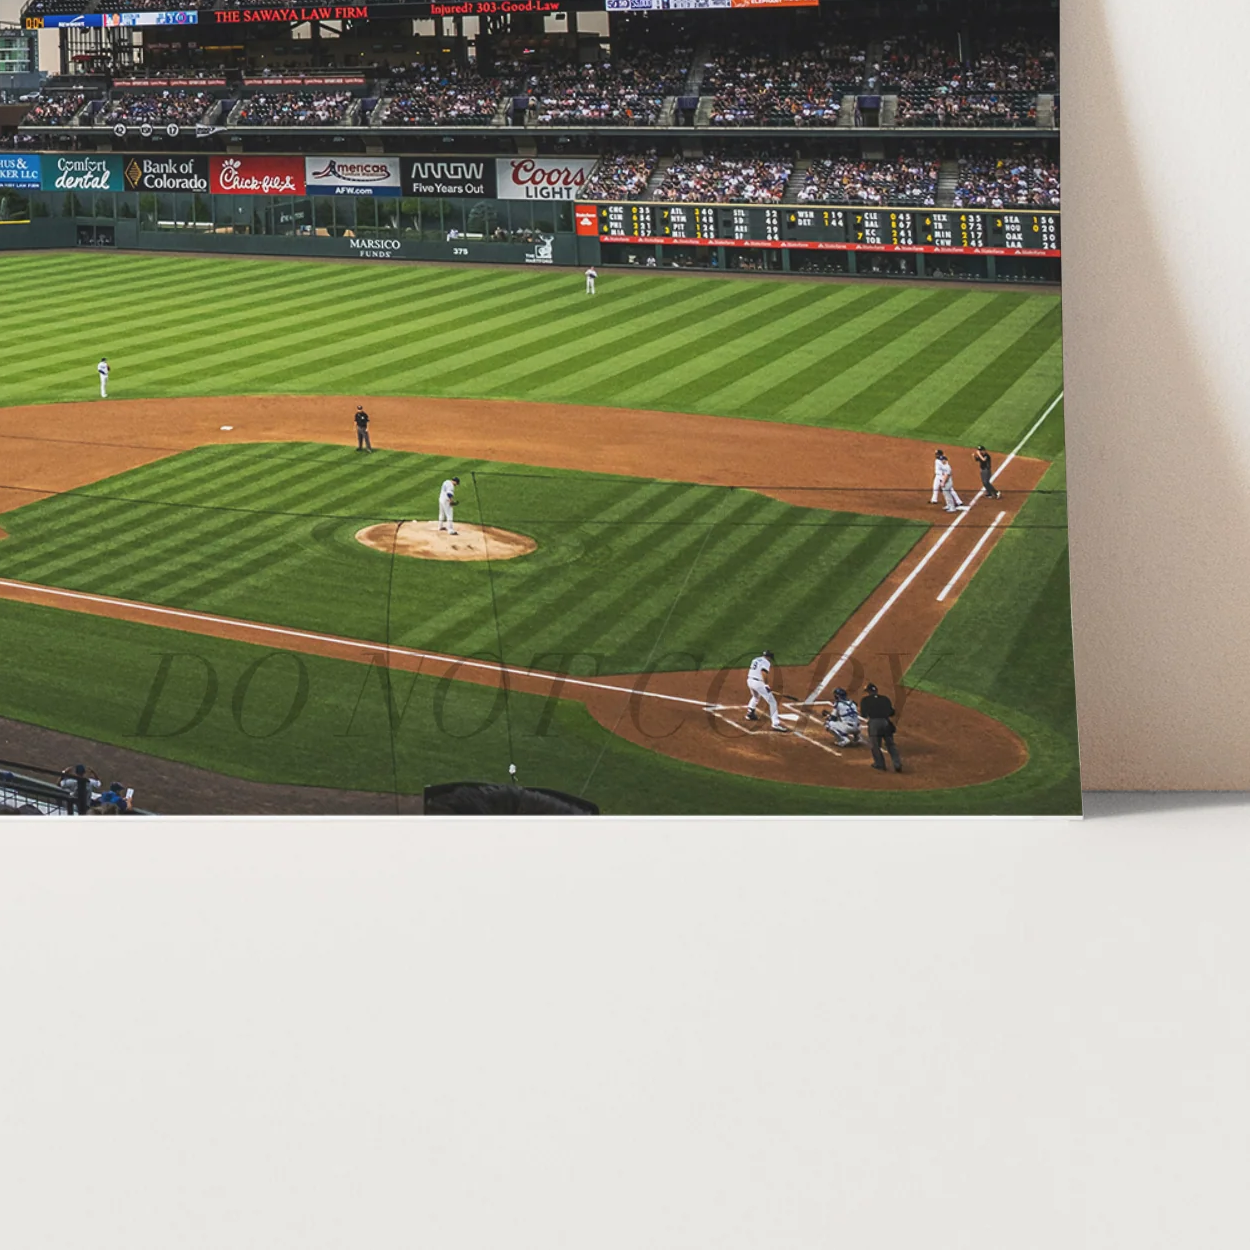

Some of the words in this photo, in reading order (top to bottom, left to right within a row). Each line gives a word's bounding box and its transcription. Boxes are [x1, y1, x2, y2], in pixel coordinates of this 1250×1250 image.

[214, 10, 240, 23] THE
[244, 9, 299, 22] SAWAYA
[301, 7, 332, 20] LAW
[335, 6, 368, 18] FIRM
[430, 2, 473, 17] Injured?
[476, 0, 560, 13] 303-Good-Law
[16, 157, 29, 170] &
[143, 159, 178, 174] Bank
[181, 159, 194, 174] of
[411, 162, 484, 179] ARROW
[21, 170, 38, 179] LLC
[55, 170, 110, 190] dental
[219, 165, 296, 194] Chick-fil-A
[510, 159, 586, 186] Coors
[143, 174, 207, 190] Colorado
[413, 183, 434, 193] Five
[434, 183, 463, 193] Years
[465, 183, 484, 193] Out
[335, 186, 373, 195] AFW.com
[526, 186, 572, 199] LIGHT
[1005, 232, 1023, 240] OAK
[350, 239, 400, 249] MARSICO
